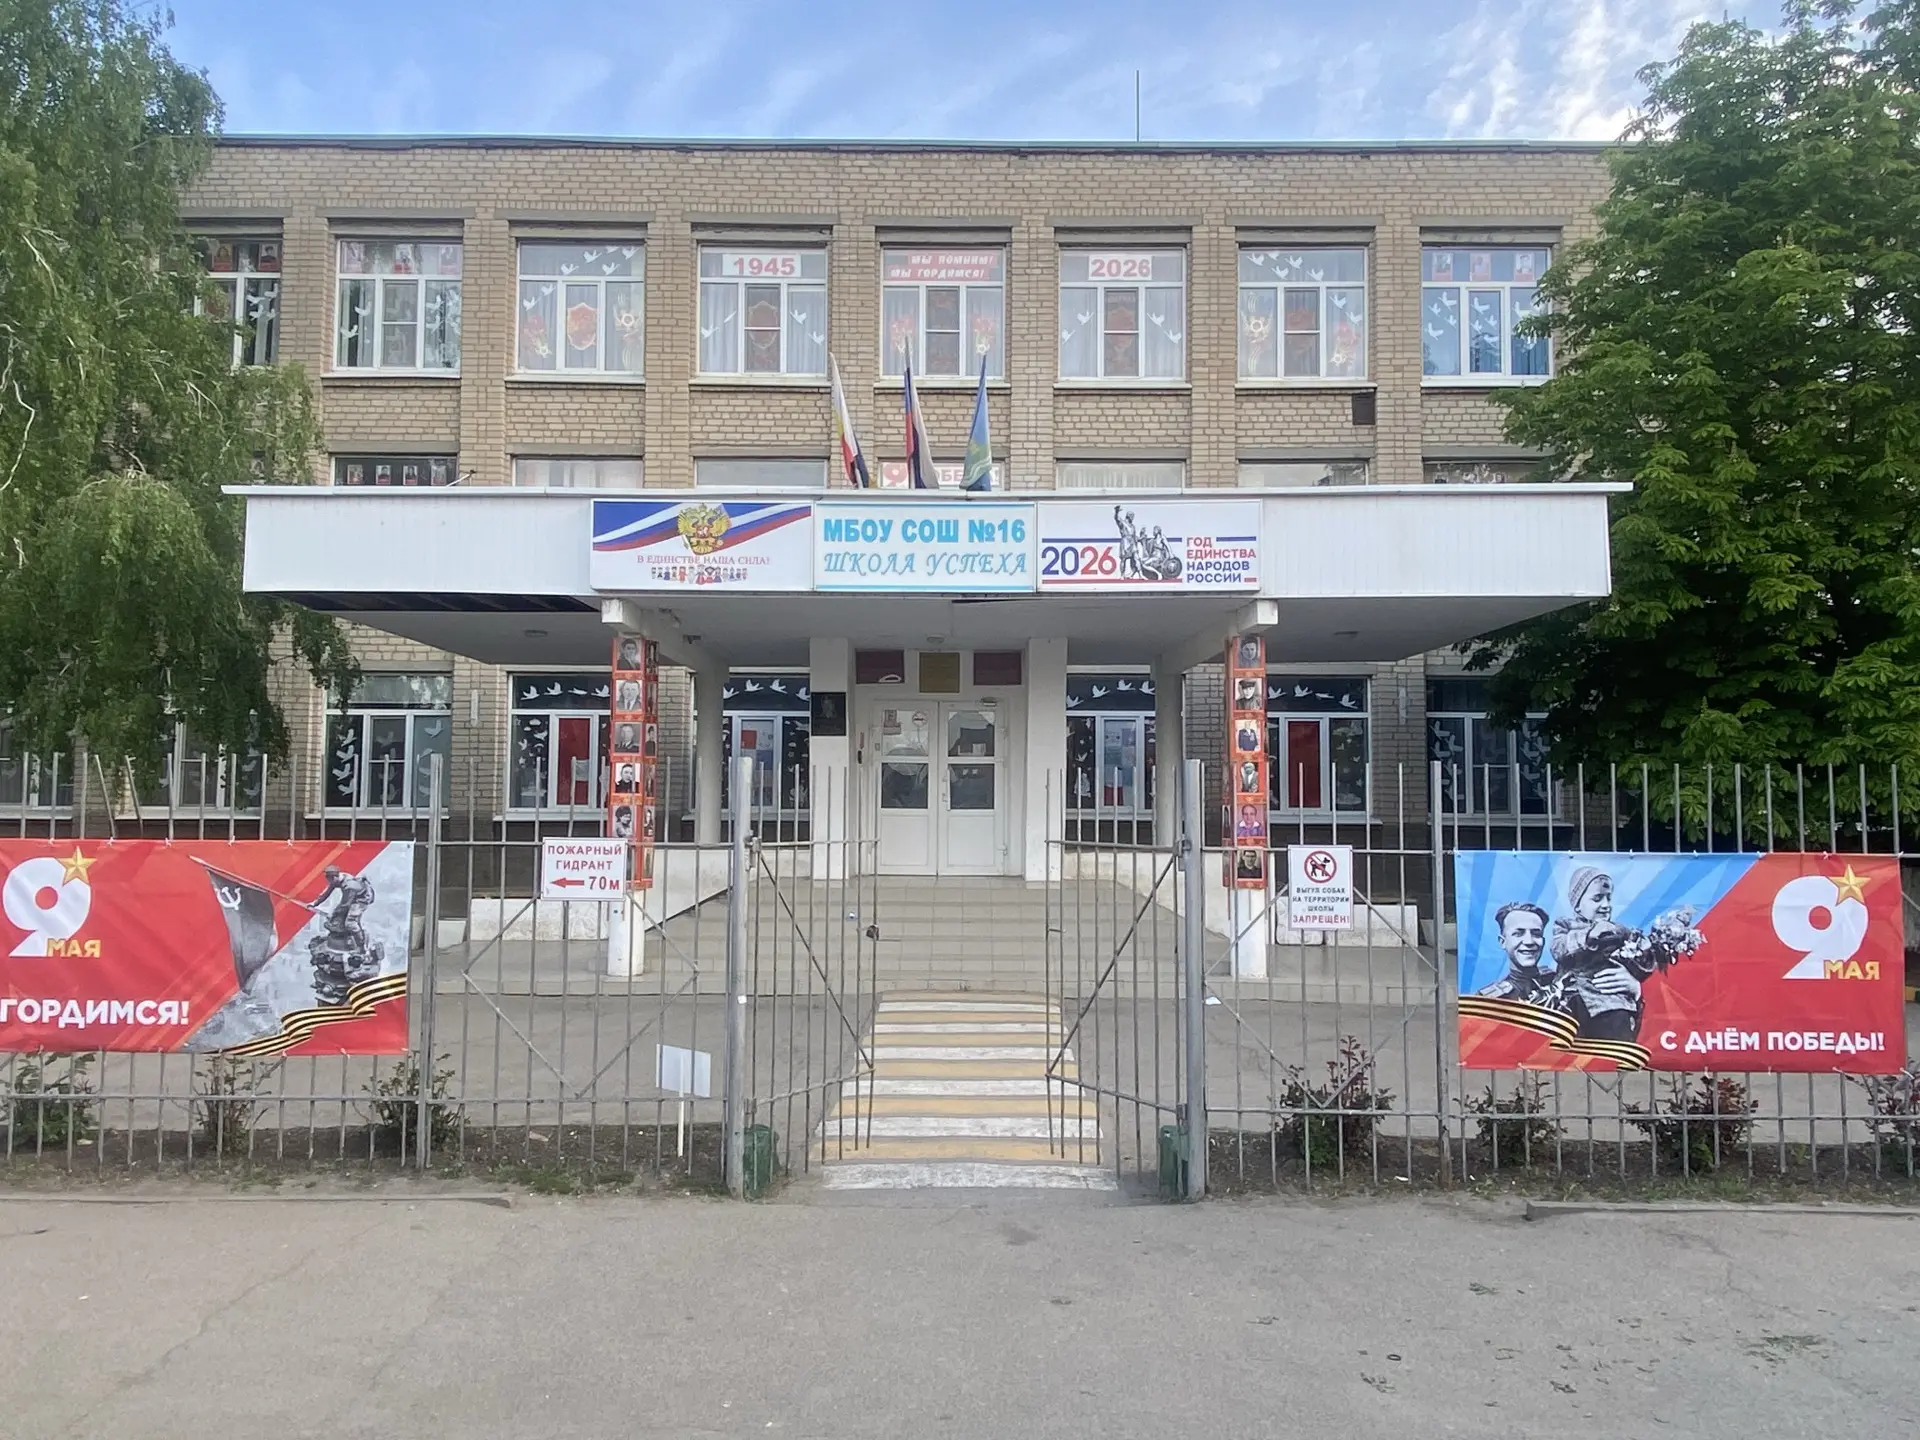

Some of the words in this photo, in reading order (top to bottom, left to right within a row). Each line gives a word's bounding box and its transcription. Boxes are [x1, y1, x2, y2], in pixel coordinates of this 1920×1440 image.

[911, 255, 933, 265] МЫ
[938, 255, 994, 265] ПОМНИМ!
[733, 257, 795, 276] 1945
[1091, 259, 1151, 278] 2026
[890, 268, 912, 278] МЫ
[917, 268, 985, 279] ГОРДИМСЯ!
[823, 518, 893, 543] МБОУ
[901, 518, 959, 543] СОШ
[968, 518, 1026, 543] №16
[1186, 537, 1213, 549] ГОД
[637, 555, 645, 563] В
[647, 556, 701, 565] ЕДИНСТВЕ
[703, 556, 736, 564] НАША
[738, 556, 771, 565] СИЛА!
[1041, 545, 1117, 576] 2026
[1186, 549, 1257, 560] ЕДИНСТВА
[823, 551, 916, 577] ШКОЛА
[926, 551, 1028, 577] УСПЕХА
[1186, 561, 1250, 573] НАРОДОВ
[1186, 573, 1242, 583] РОССИИ
[547, 844, 622, 855] ПОЖАРНЫЙ
[556, 860, 613, 871] ГИДРАНТ
[2, 856, 91, 957] 9
[47, 938, 101, 958] МАЯ
[1292, 914, 1350, 924] ЗАПРЕЩЁН!
[1771, 875, 1869, 979] 9
[1824, 960, 1880, 980] МАЯ
[0, 999, 190, 1029] ГОРДИМСЯ!
[1660, 1031, 1678, 1050] С
[1685, 1028, 1760, 1054] ДНЁМ
[1767, 1031, 1885, 1054] ПОБЕДЫ!
